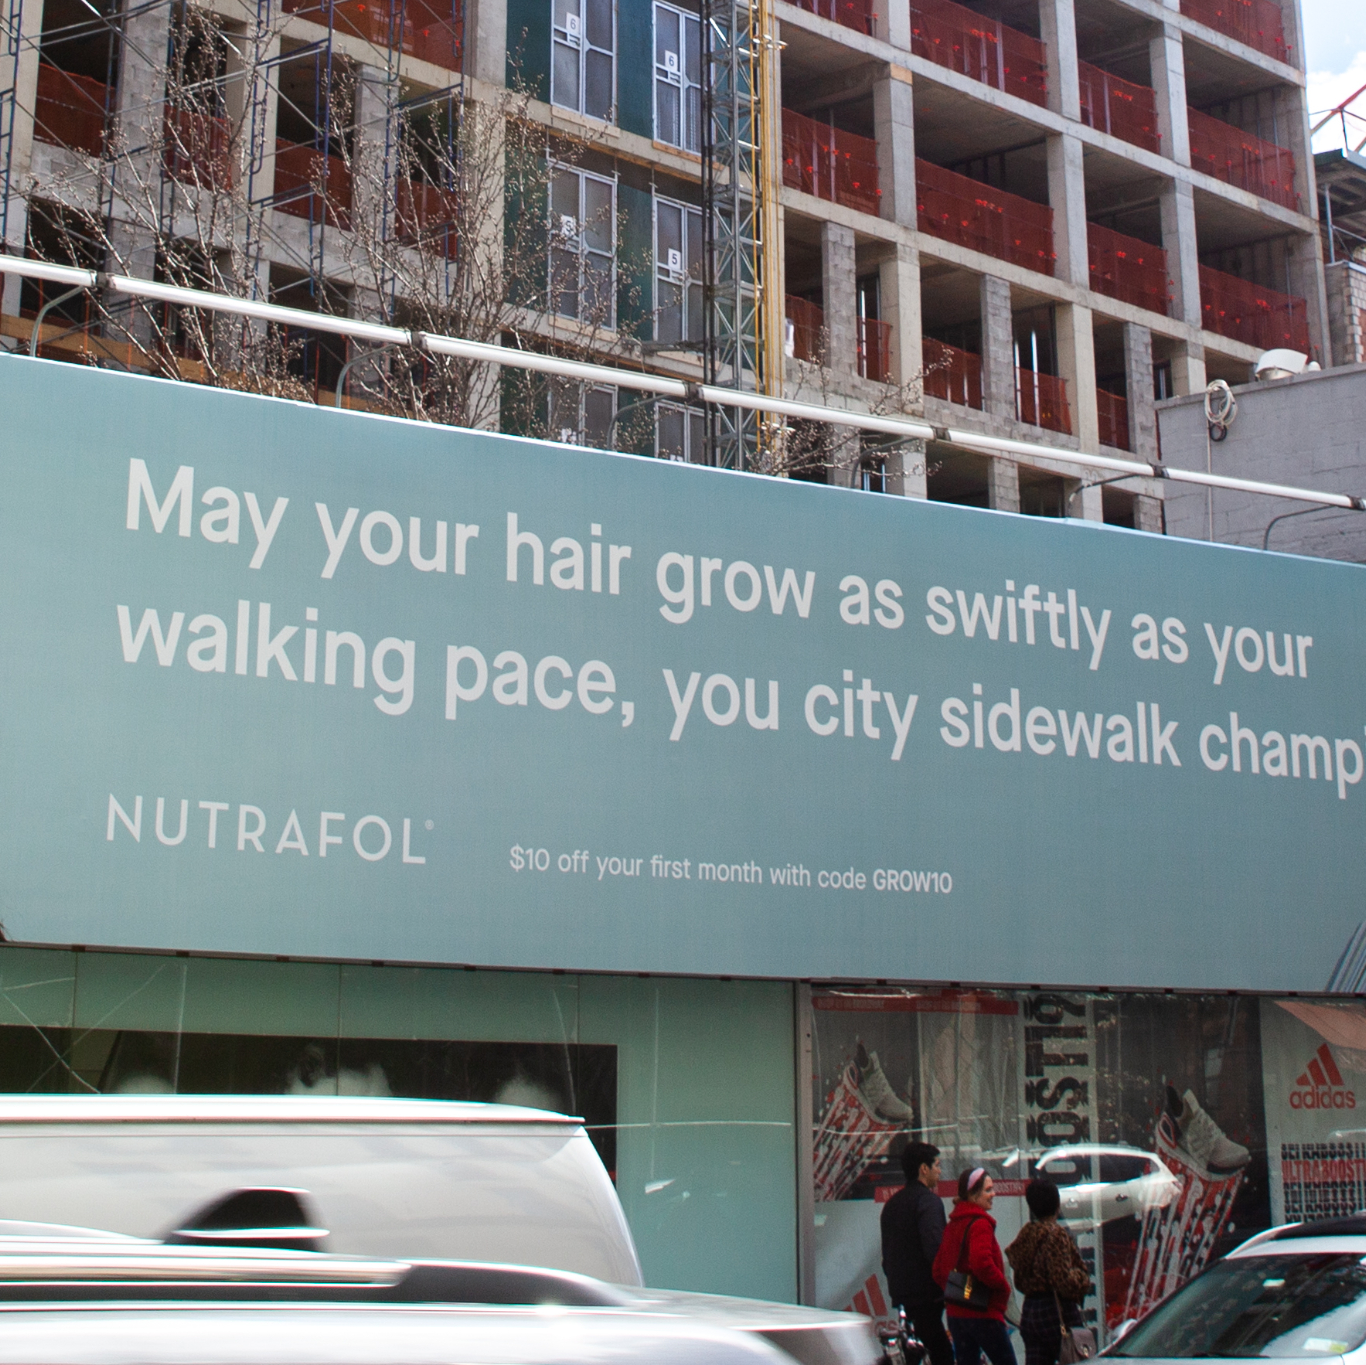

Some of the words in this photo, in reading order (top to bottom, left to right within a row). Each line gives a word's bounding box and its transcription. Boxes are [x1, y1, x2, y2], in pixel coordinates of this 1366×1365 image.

[126, 457, 290, 570] May
[315, 502, 479, 579] your
[506, 511, 632, 595] hair
[656, 550, 816, 625] grow
[838, 574, 904, 629] as
[925, 579, 1111, 671] swiftly
[1131, 612, 1188, 664] as
[1204, 622, 1313, 685] your
[117, 600, 415, 716] walking
[445, 643, 635, 727] pace,
[662, 668, 779, 741] you
[804, 669, 918, 761] city
[939, 682, 1182, 768] sidewalk
[106, 792, 427, 865] NUTRAFOL
[509, 843, 551, 873] $10
[558, 850, 590, 874] off
[596, 854, 643, 881] your
[650, 854, 691, 879] first
[698, 860, 763, 885] month
[770, 863, 811, 887] with
[817, 867, 867, 890] code
[873, 868, 953, 894] GROW10
[1289, 1085, 1356, 1110] adidas
